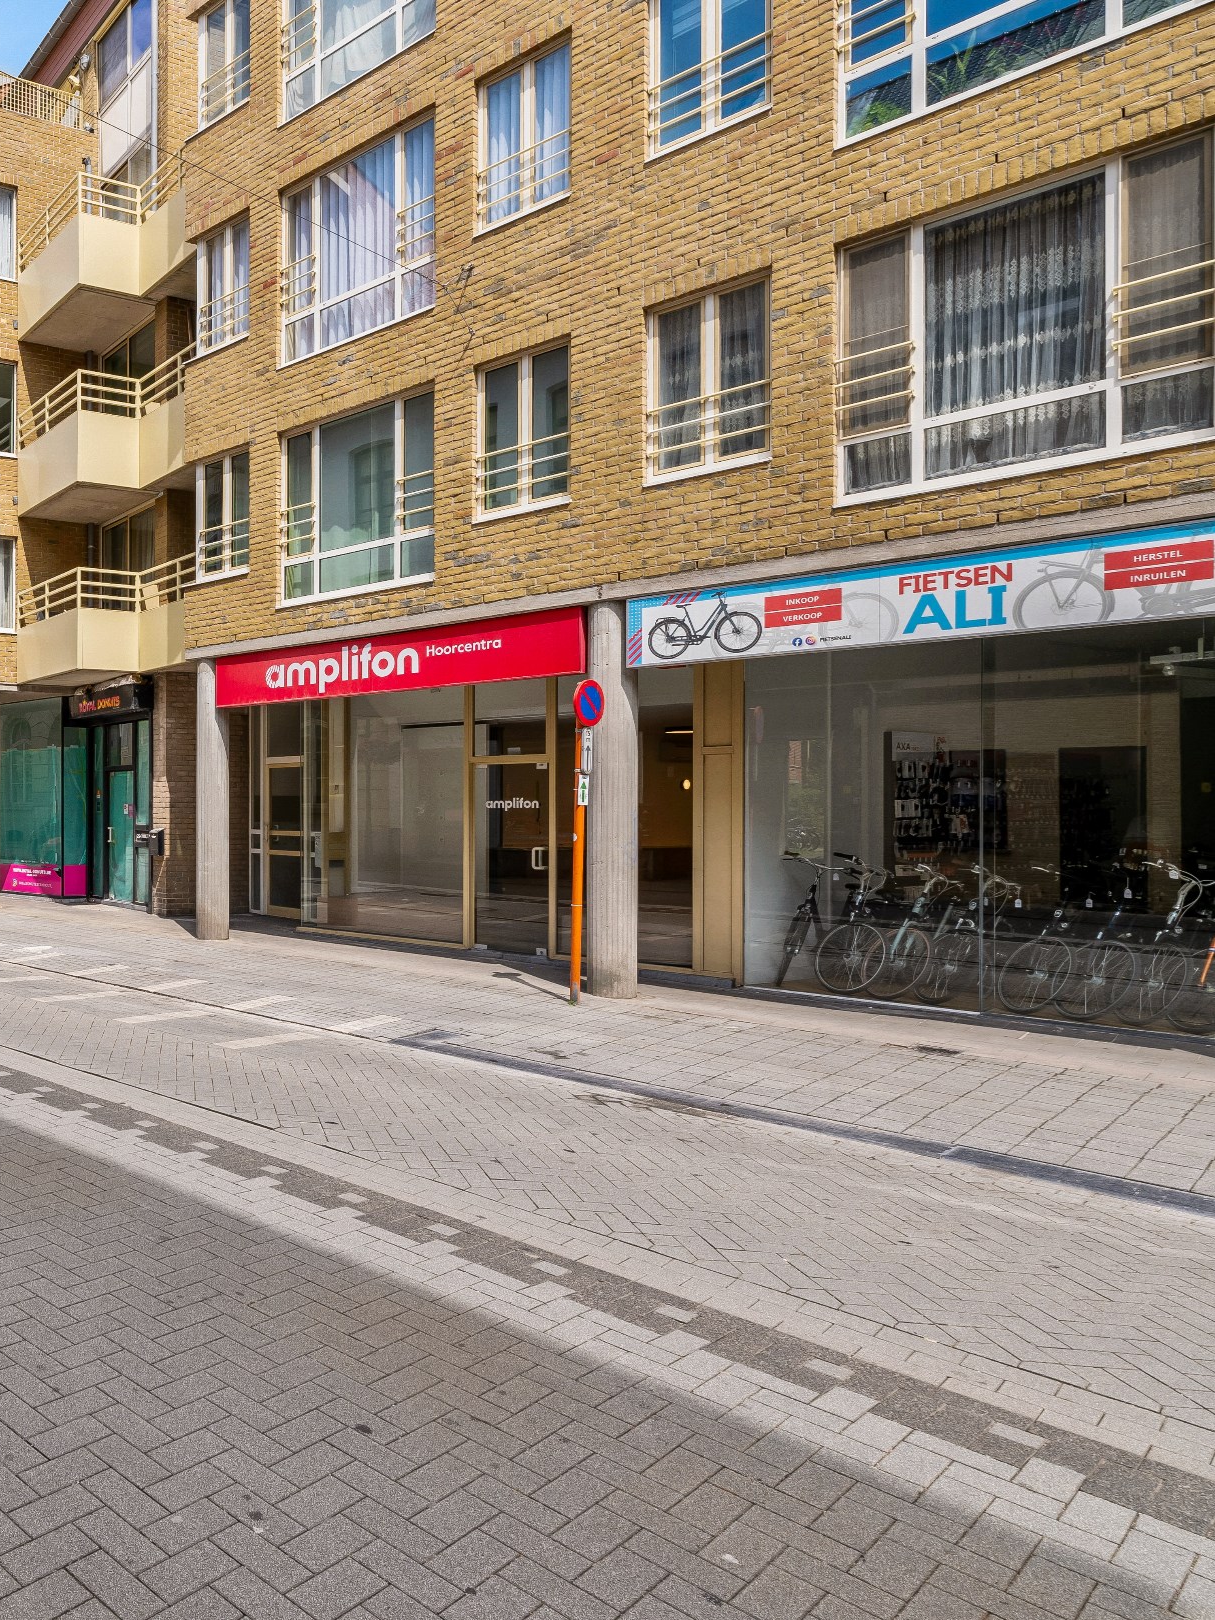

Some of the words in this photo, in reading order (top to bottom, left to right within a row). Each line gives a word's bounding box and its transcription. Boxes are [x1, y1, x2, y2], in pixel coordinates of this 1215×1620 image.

[1133, 550, 1183, 562] HERSTEL
[898, 563, 1013, 595] FIETSEN
[1130, 570, 1186, 582] INRUILEN
[786, 595, 820, 606] INKOOP
[902, 585, 1007, 634] ALI
[783, 612, 823, 622] VERKOOP
[265, 643, 419, 693] amplifon
[426, 638, 502, 657] Hoorcentra
[897, 742, 910, 751] AXA
[485, 797, 539, 812] amplifon
